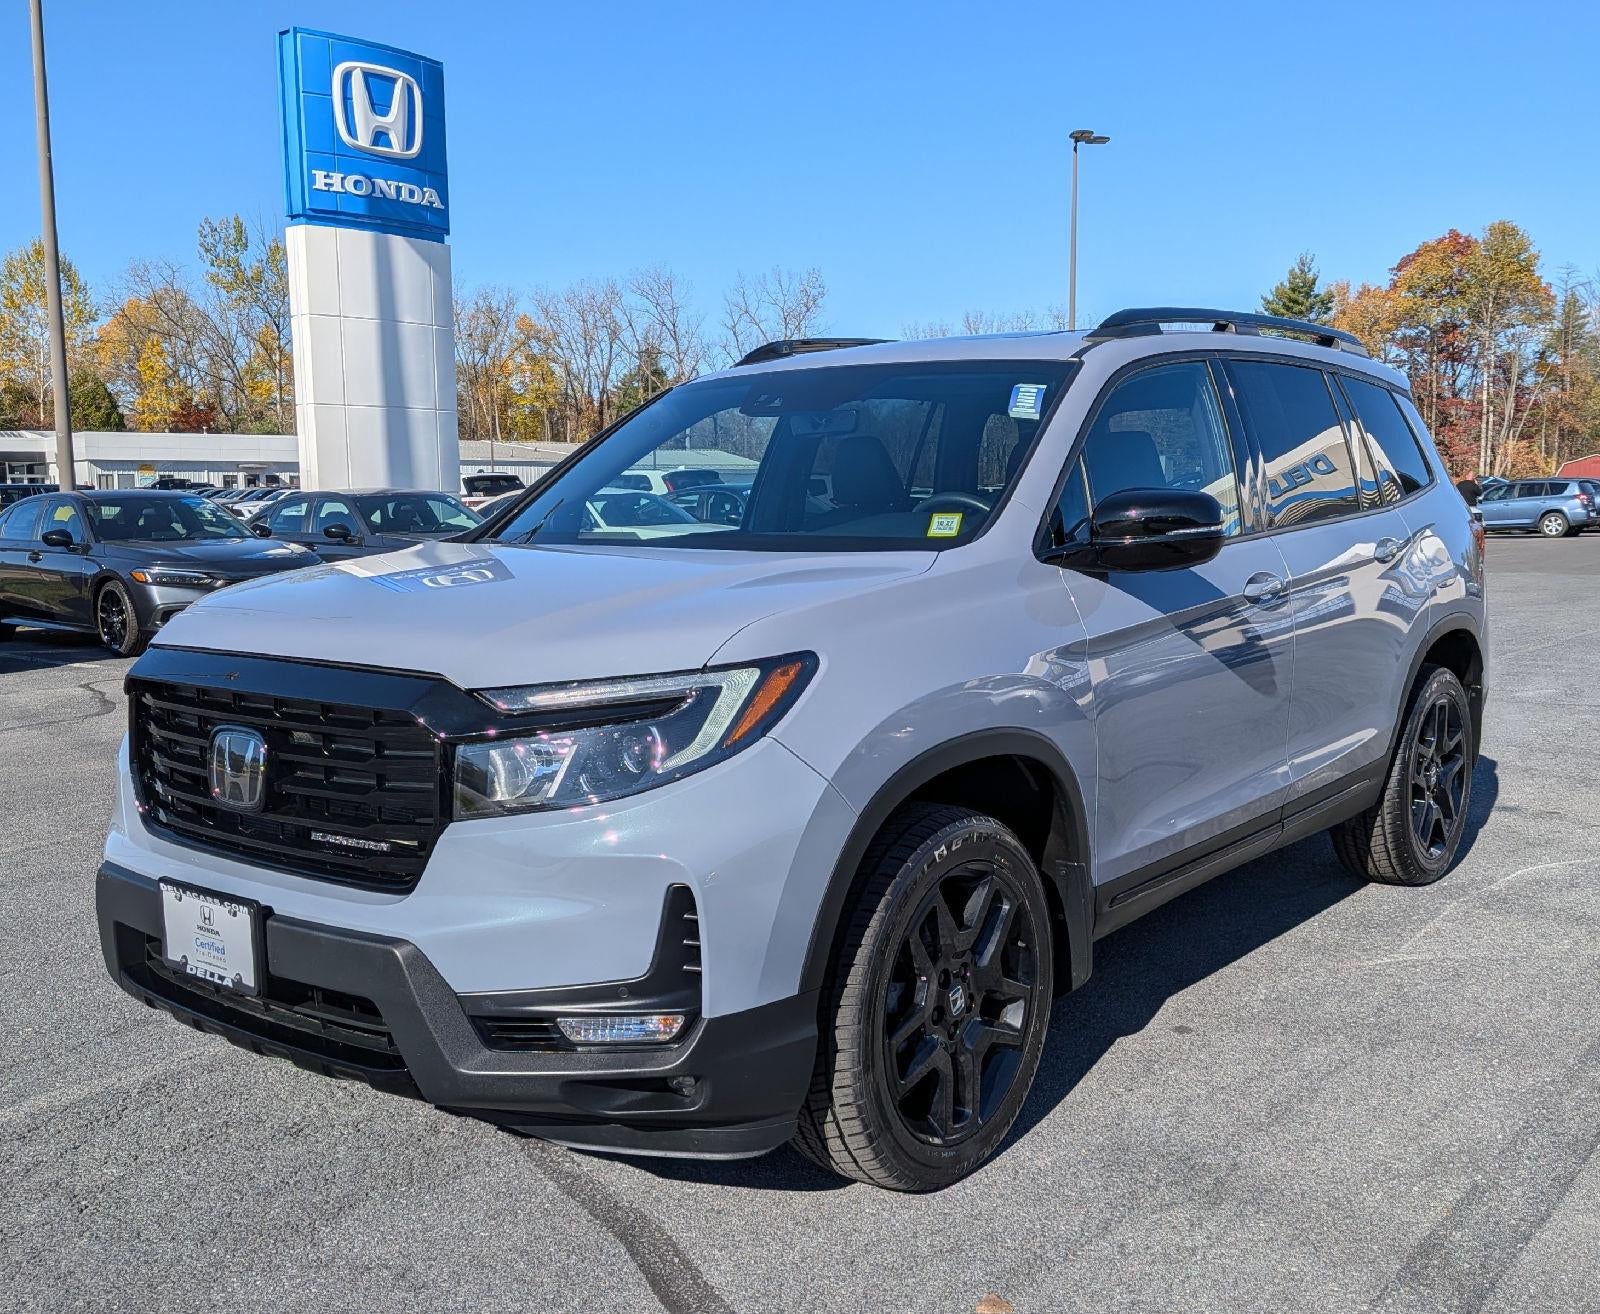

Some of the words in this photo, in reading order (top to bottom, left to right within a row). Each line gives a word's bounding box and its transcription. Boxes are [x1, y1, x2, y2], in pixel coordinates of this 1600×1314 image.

[312, 169, 445, 209] HONDA
[196, 924, 221, 937] HONDA
[195, 937, 226, 956] Certified
[186, 964, 234, 988] DELLA
